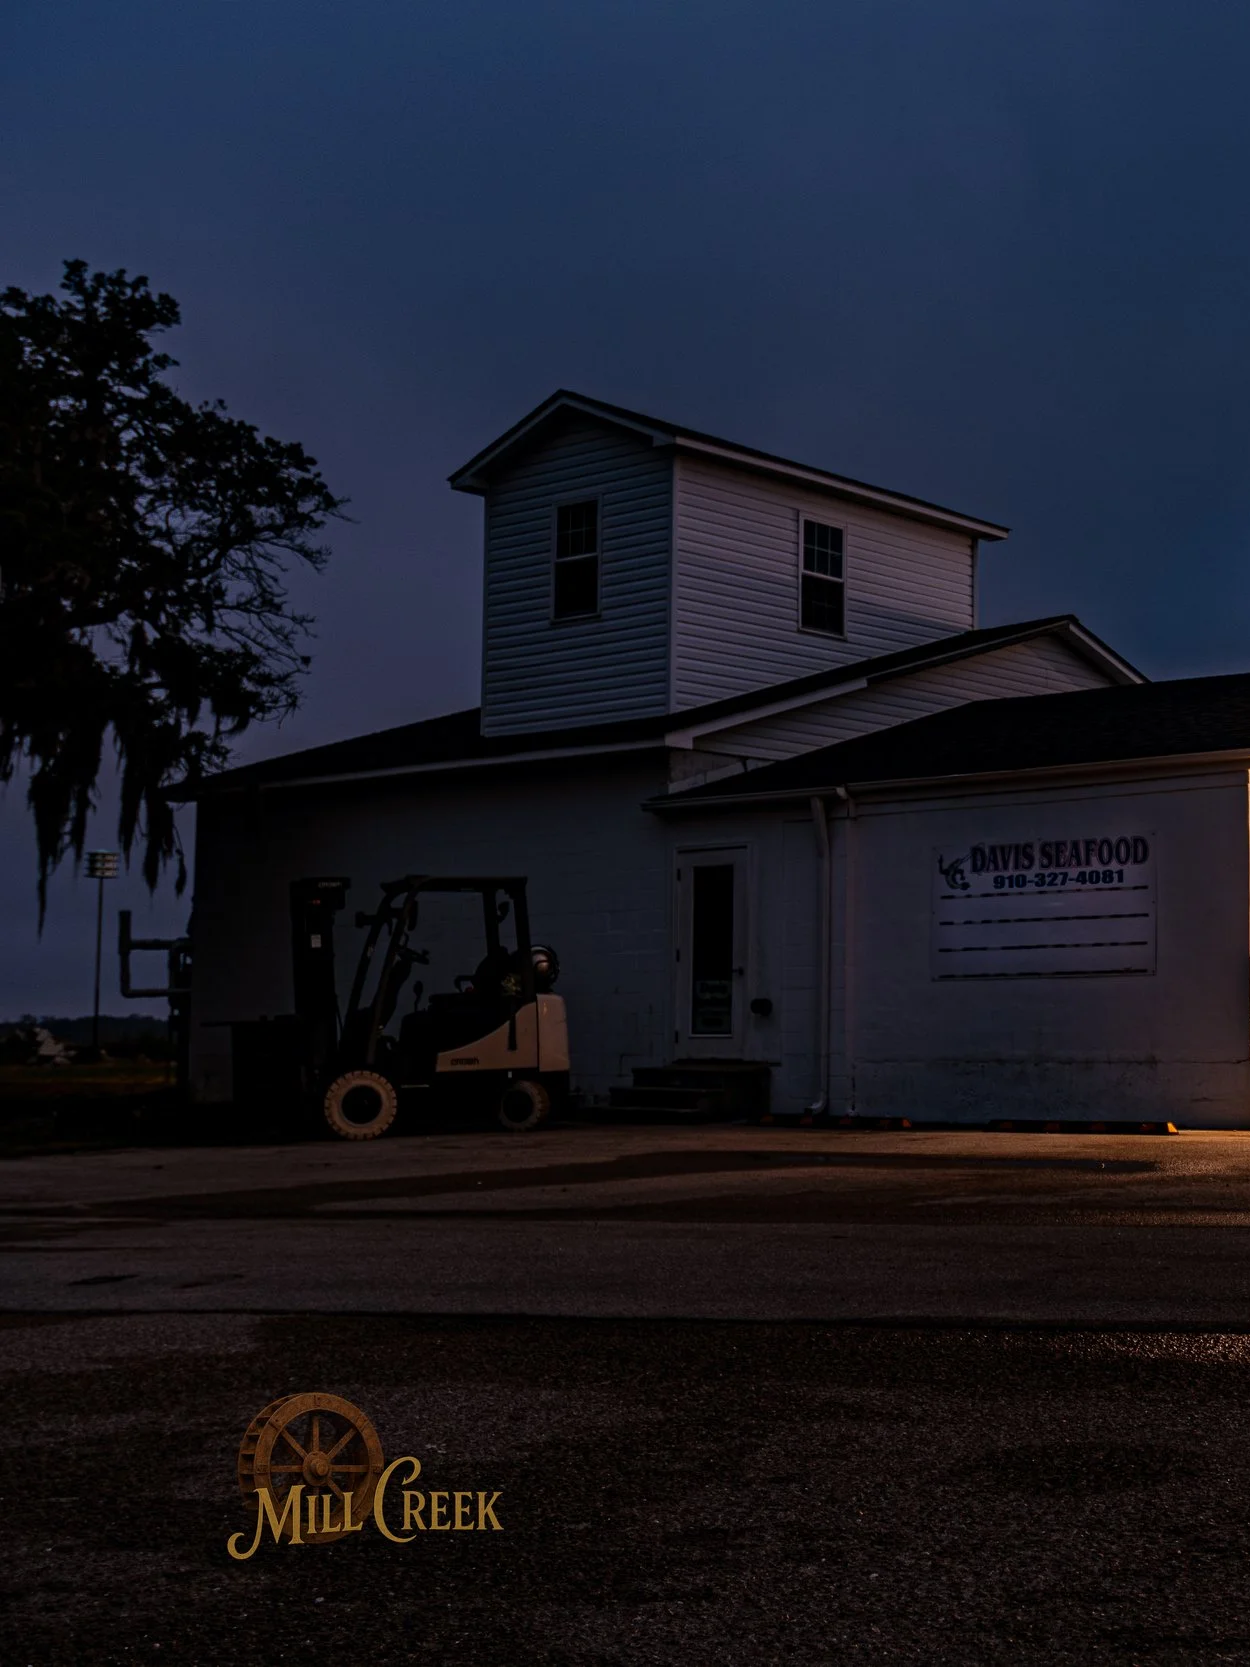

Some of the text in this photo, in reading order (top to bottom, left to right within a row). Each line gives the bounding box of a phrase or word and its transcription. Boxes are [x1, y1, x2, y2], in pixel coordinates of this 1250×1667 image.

[971, 837, 1149, 873] DAVIS SEAFOOD
[993, 869, 1125, 889] 910-327-4081
